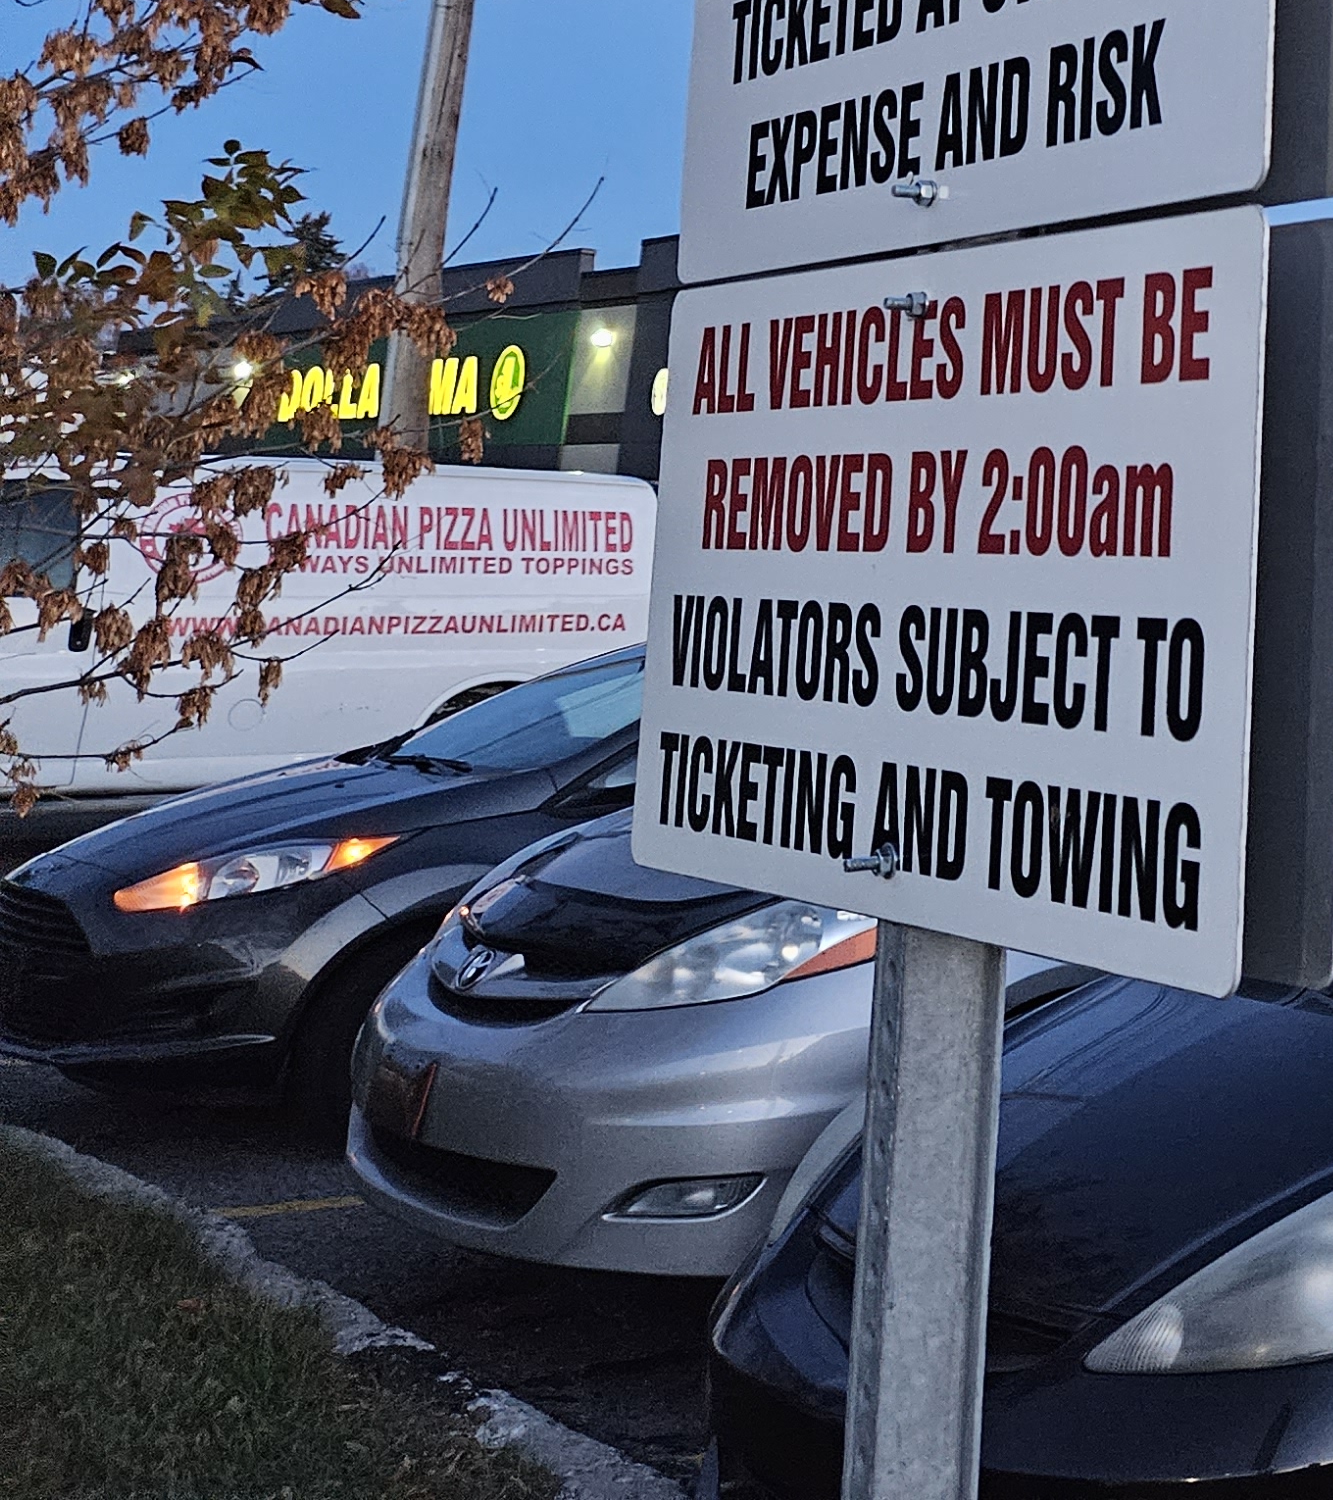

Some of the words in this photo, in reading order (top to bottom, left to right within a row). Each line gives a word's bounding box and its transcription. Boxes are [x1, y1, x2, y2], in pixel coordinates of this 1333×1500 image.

[745, 81, 925, 210] EXPENSE
[935, 55, 1031, 172] AND
[1046, 18, 1166, 147] RISK
[278, 356, 478, 422] DOLLAMA
[692, 322, 755, 416] ALL
[769, 296, 966, 411] VEHICLES
[980, 277, 1125, 396] MUST
[1141, 266, 1214, 384] BE
[265, 502, 408, 550] CANADIAN
[420, 506, 494, 550] PIZZA
[503, 508, 633, 553] UNLIMITED
[380, 556, 513, 574] UNLIMITED
[521, 557, 634, 575] TOPPINGS
[701, 452, 893, 553] REMOVED
[906, 449, 967, 555] BY
[977, 445, 1174, 558] 2:00am
[672, 593, 881, 707] VIOLATORS
[895, 606, 1120, 733] SUBJECT
[1137, 617, 1206, 742] TO
[659, 731, 857, 860] TICKETING
[870, 761, 968, 882] AND
[986, 778, 1201, 931] TOWING
